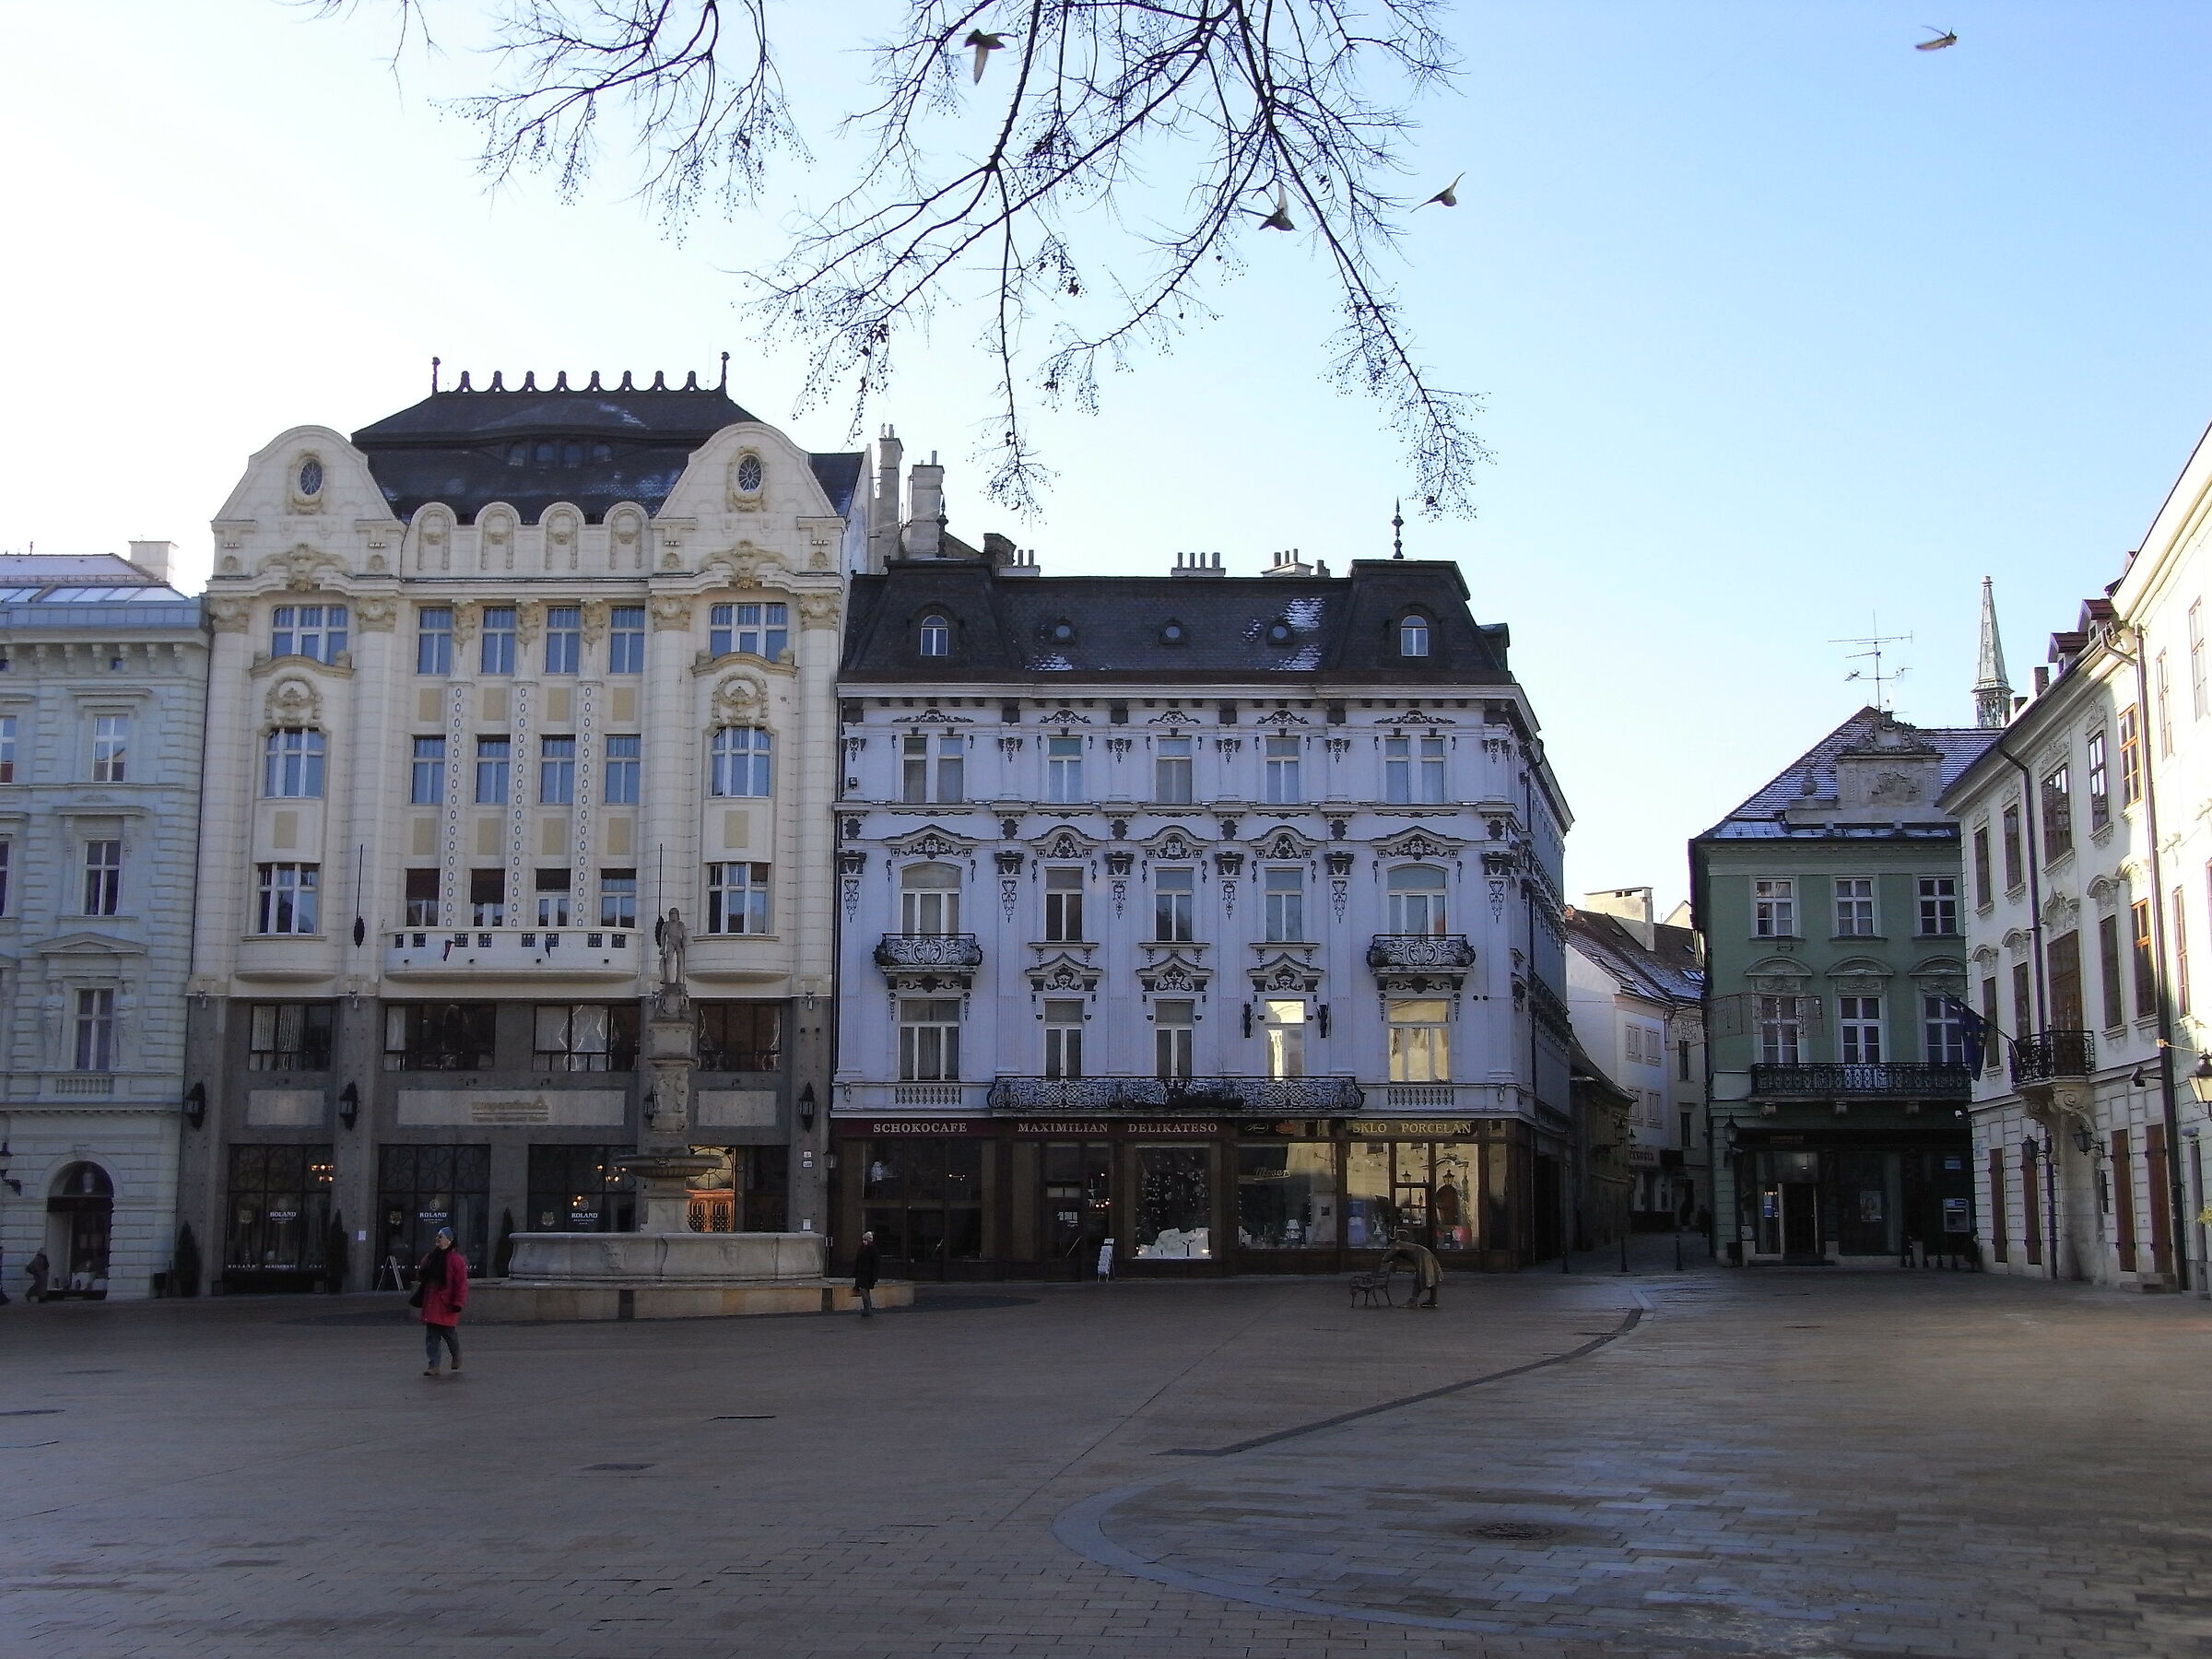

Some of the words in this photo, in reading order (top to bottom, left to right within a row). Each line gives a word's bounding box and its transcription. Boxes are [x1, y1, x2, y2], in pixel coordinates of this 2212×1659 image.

[872, 1122, 968, 1134] SCHOKOCAFE
[1018, 1122, 1109, 1134] MAXIMILIAN
[1127, 1122, 1218, 1134] DELIKATESO
[1352, 1122, 1387, 1135] SKLO
